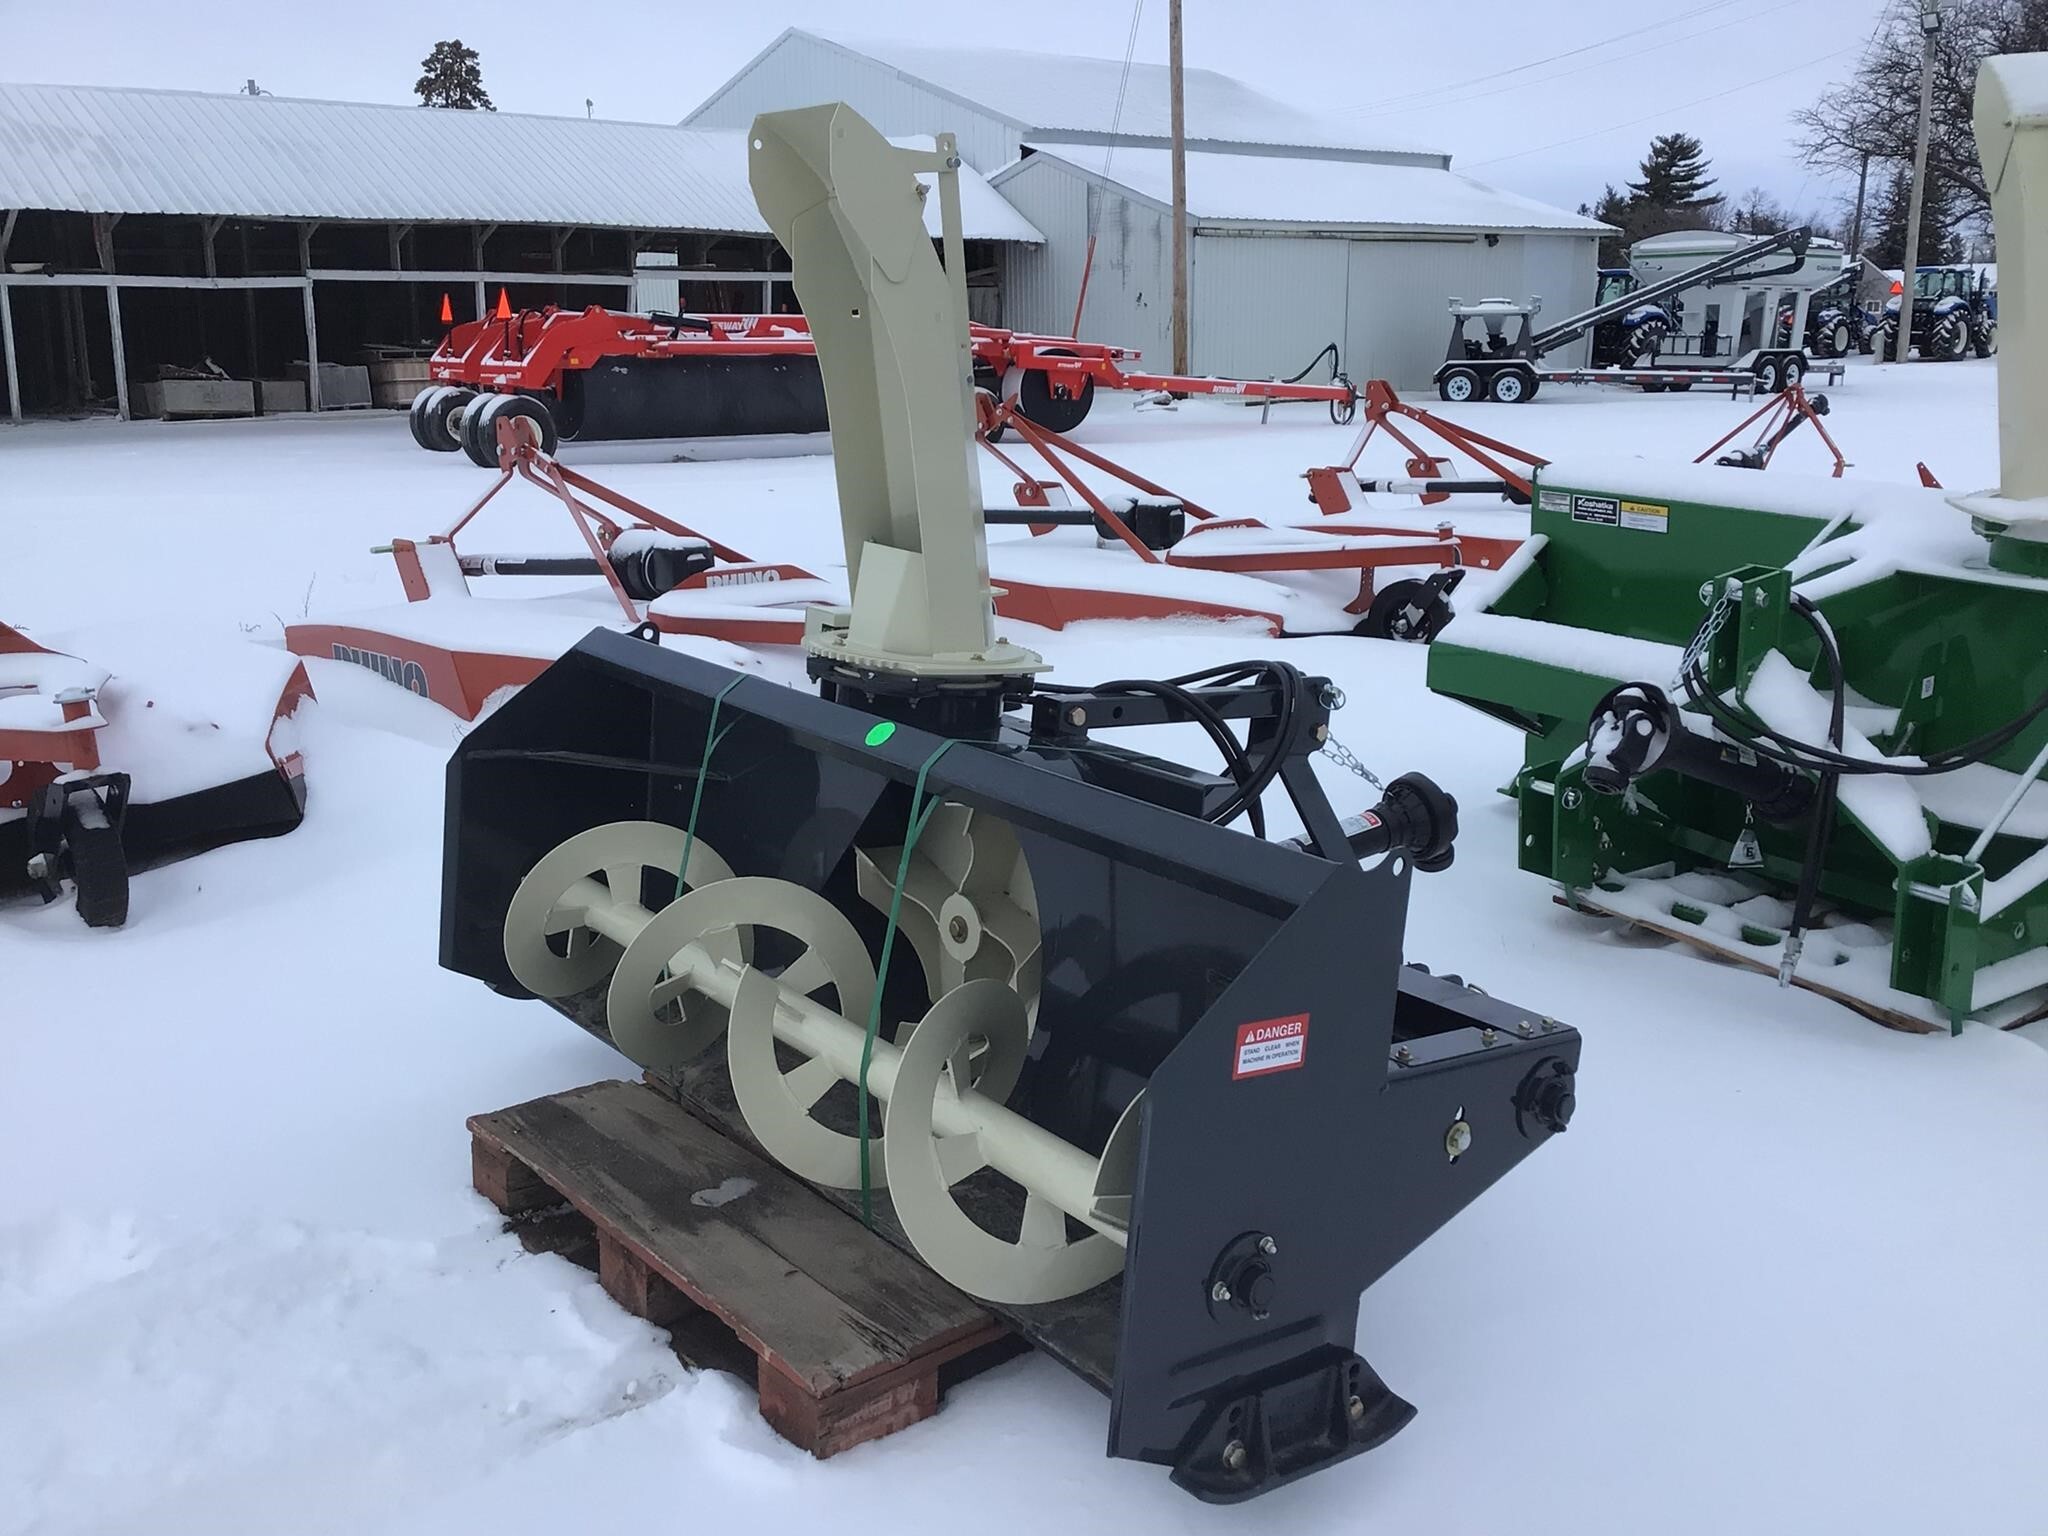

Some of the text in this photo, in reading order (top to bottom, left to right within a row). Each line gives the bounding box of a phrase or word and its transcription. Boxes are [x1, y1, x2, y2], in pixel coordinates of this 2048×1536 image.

[1256, 1022, 1302, 1041] DANGER
[1244, 1040, 1300, 1056] STAND CLEAR WHEN
[1242, 1055, 1265, 1064] MACHINE
[1271, 1049, 1299, 1060] OPERATION
